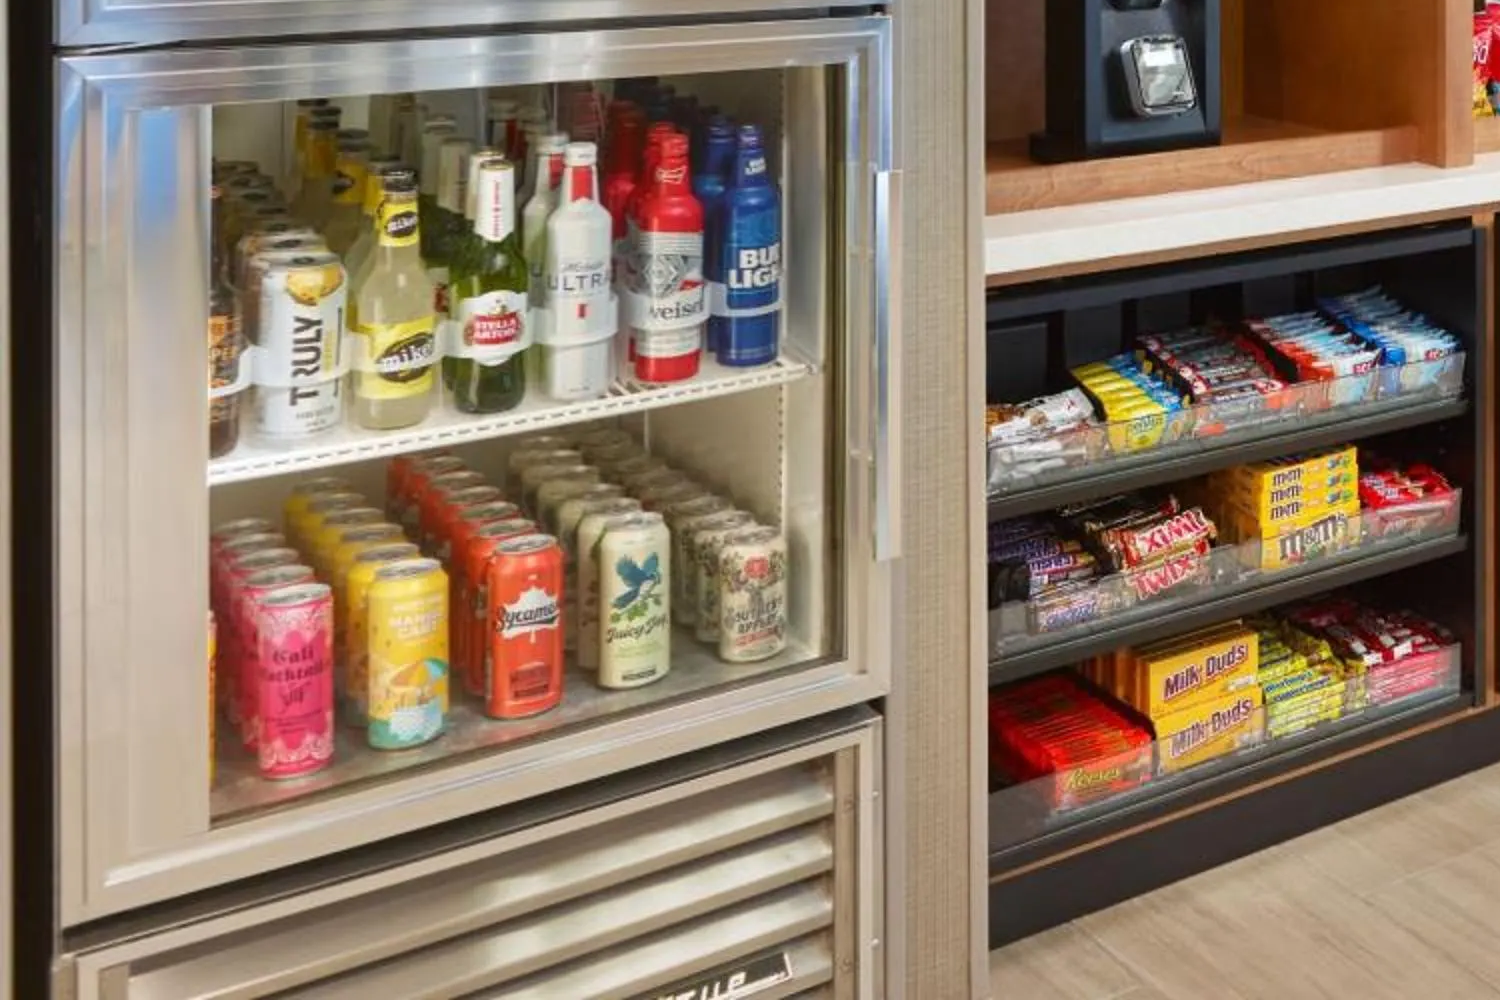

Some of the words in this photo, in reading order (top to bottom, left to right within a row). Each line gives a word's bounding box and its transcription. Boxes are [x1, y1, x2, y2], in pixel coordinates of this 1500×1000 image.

[290, 316, 324, 406] TRULY
[1163, 662, 1201, 701] Milk
[1205, 643, 1249, 679] Duds
[1171, 720, 1207, 759] Milk
[1211, 697, 1253, 734] Duds
